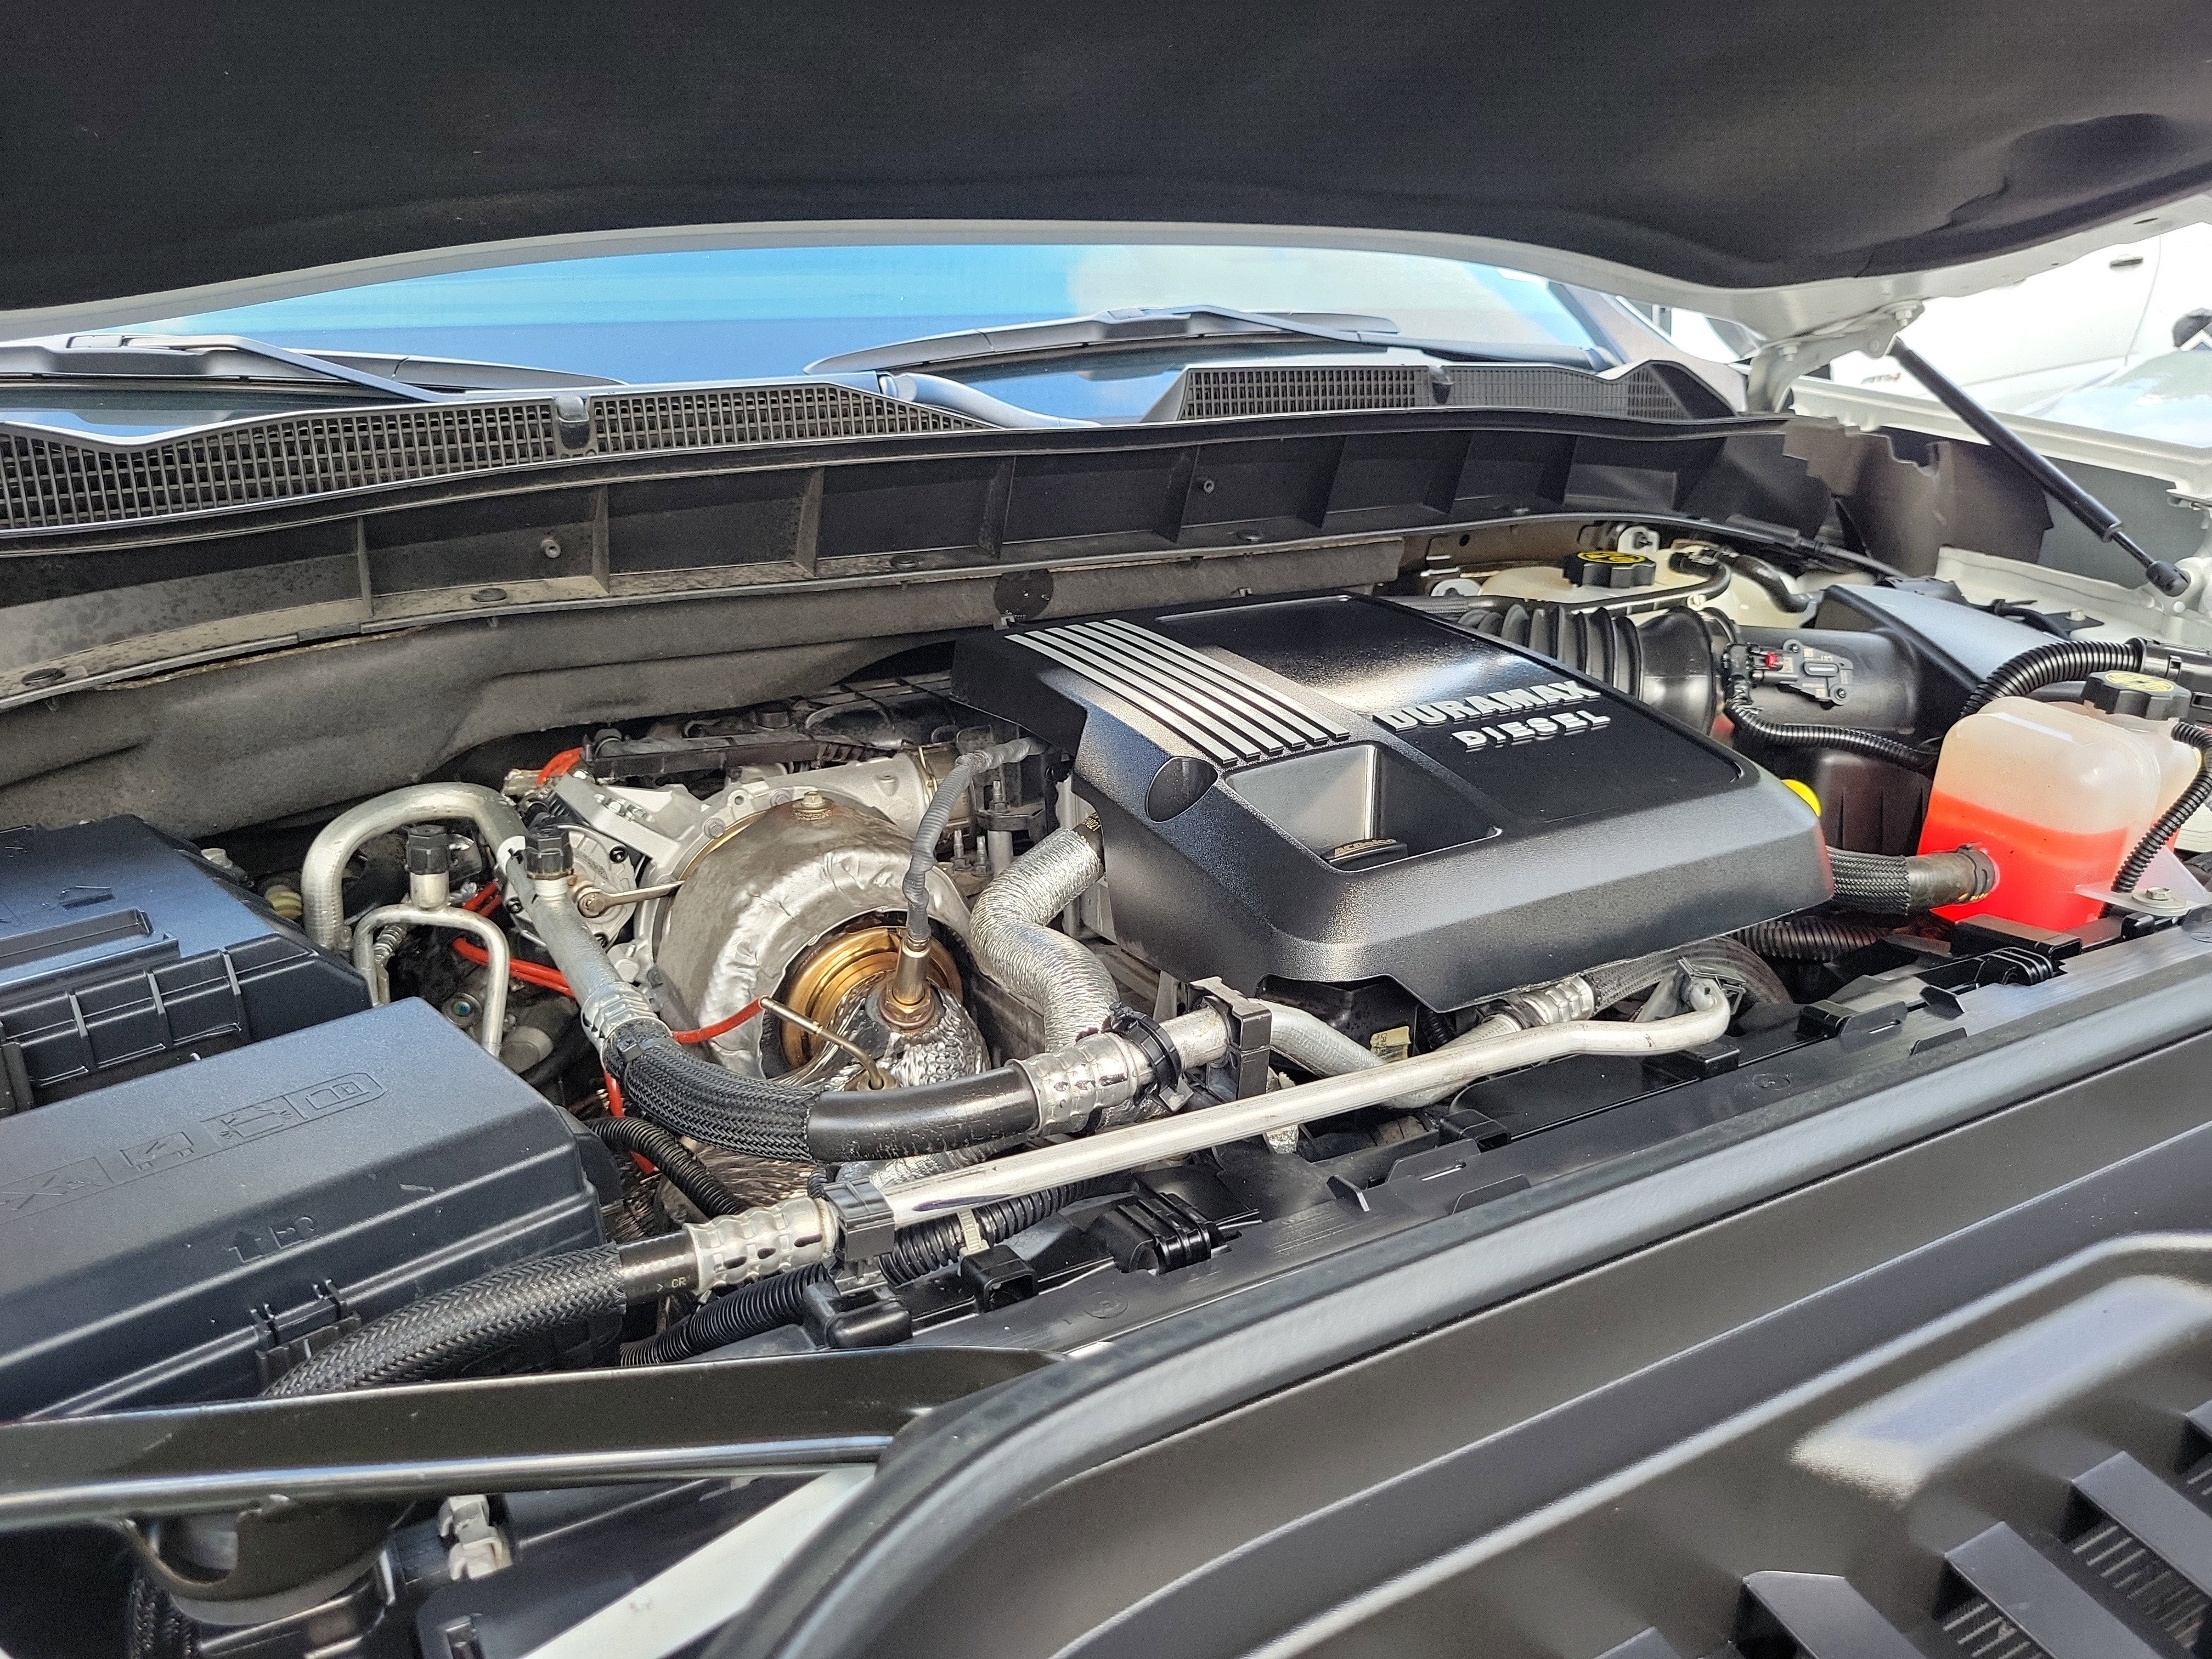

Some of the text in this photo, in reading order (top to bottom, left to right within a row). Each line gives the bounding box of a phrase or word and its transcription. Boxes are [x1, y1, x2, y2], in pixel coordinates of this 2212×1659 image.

[1373, 680, 1601, 732] DURAMAX
[1451, 710, 1611, 752] DIESEL
[1334, 839, 1397, 855] ACDelco
